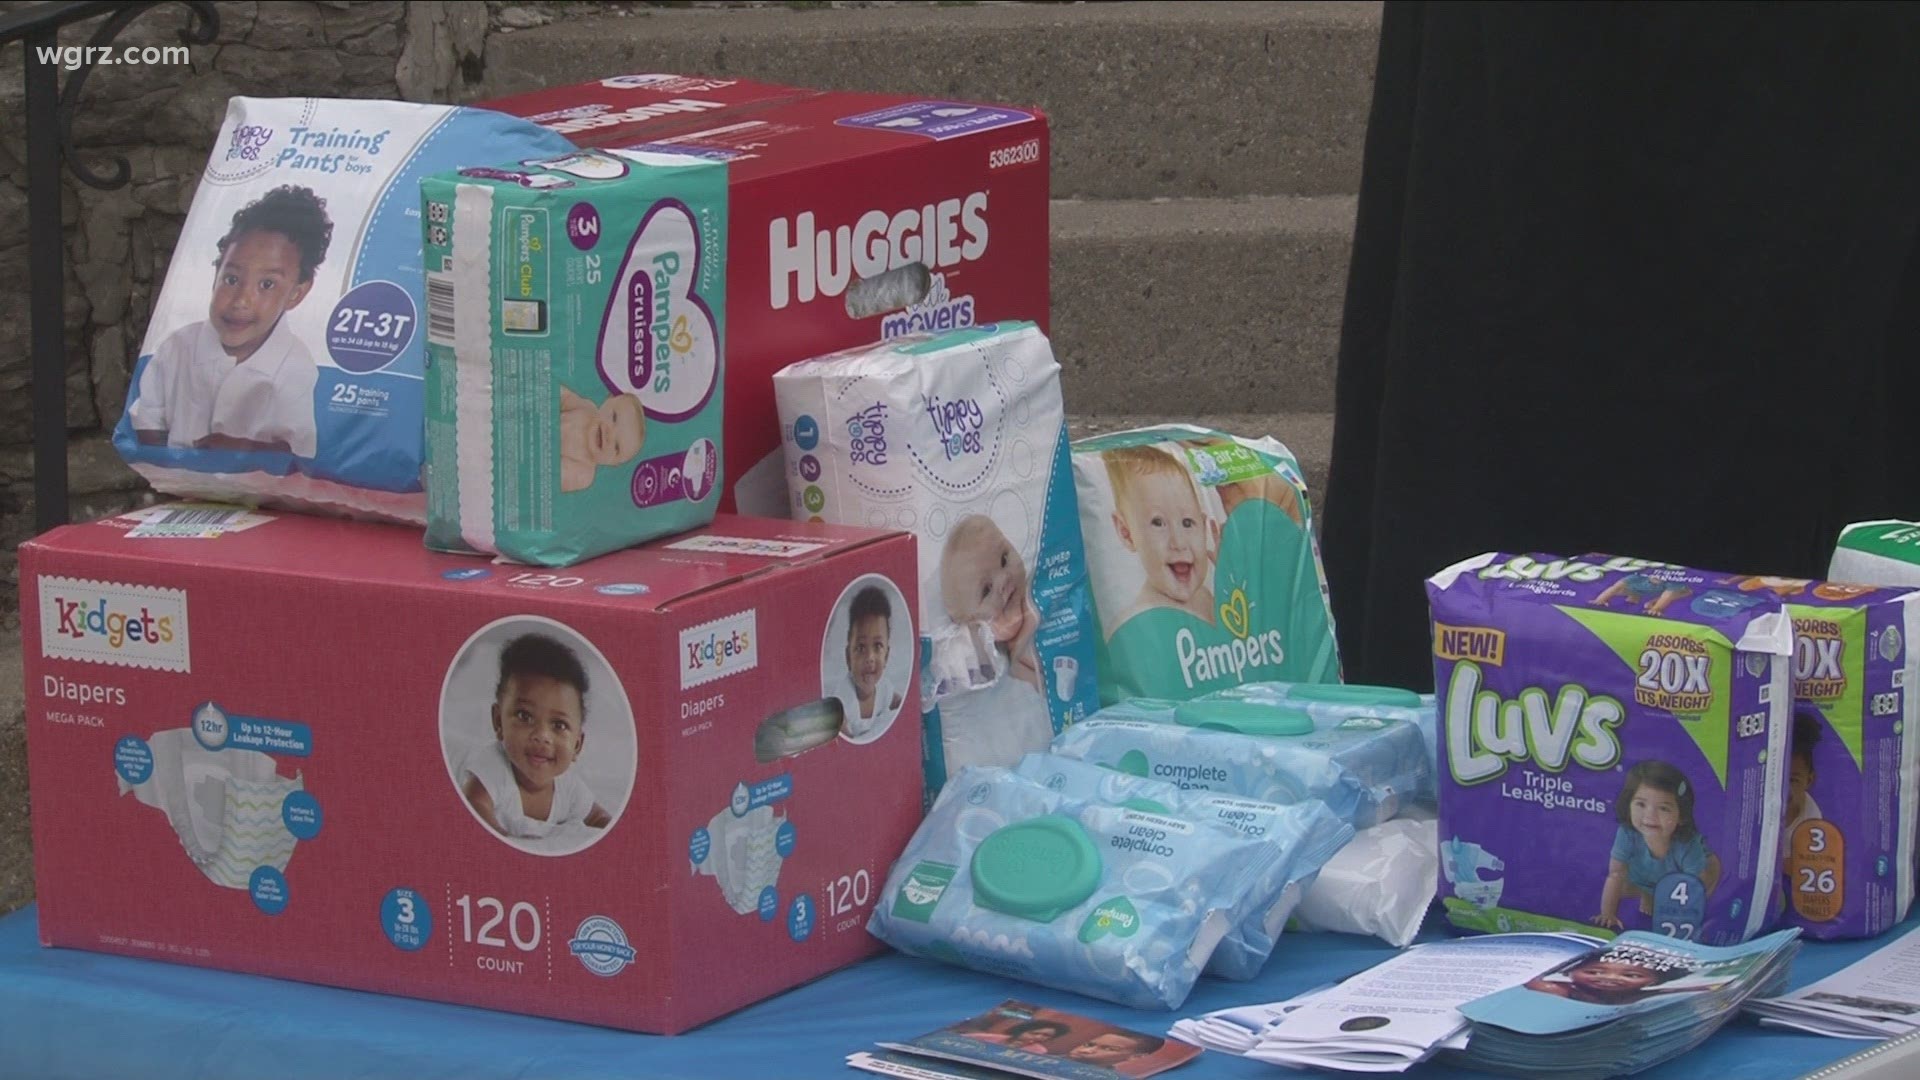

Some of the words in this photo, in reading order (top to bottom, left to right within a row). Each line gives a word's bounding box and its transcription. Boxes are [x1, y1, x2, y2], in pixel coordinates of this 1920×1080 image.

[289, 127, 390, 155] Training
[275, 148, 344, 173] Pants
[345, 161, 372, 175] boys
[577, 216, 597, 236] 3
[520, 214, 535, 262] Pampers
[769, 192, 989, 310] HUGGIES
[521, 264, 532, 297] Club
[586, 254, 601, 285] 25
[334, 308, 410, 339] 2T-3T
[633, 283, 645, 377] cruisers
[651, 251, 680, 394] Pampers
[884, 300, 972, 339] movers
[331, 383, 358, 403] 25
[357, 397, 380, 407] pants
[358, 387, 390, 401] training
[926, 396, 984, 436] tippy
[798, 427, 814, 438] 1
[846, 411, 864, 466] toes
[864, 401, 887, 465] tippy
[940, 431, 982, 462] toes
[804, 461, 817, 474] 2
[808, 493, 820, 504] 3
[508, 573, 584, 588] 120
[1048, 565, 1071, 580] PACK
[1478, 555, 1604, 583] Luvs
[55, 598, 174, 648] Kidgets
[1793, 618, 1839, 636] SORBS
[687, 630, 750, 670] Kidgets
[1442, 629, 1498, 660] NEW!
[1646, 634, 1705, 653] ABSORBS
[1175, 627, 1285, 689] Pampers
[1794, 636, 1843, 681] 0X
[1637, 649, 1711, 695] 20X
[44, 675, 126, 706] Diapers
[1636, 690, 1656, 707] ITS
[1658, 693, 1711, 711] WEIGHT
[681, 693, 725, 719] Diapers
[46, 711, 75, 725] MEGA
[77, 713, 105, 728] PACK
[200, 720, 223, 733] 12hr
[240, 721, 252, 734] Up
[253, 723, 261, 734] to
[263, 724, 293, 738] 12-Hour
[1447, 661, 1623, 784] Luvs
[233, 732, 264, 746] Leakage
[266, 737, 305, 750] Protection
[1154, 761, 1228, 782] complete
[1523, 770, 1573, 793] Triple
[1502, 782, 1606, 814] Leakguards
[1146, 815, 1169, 827] FRESH
[1170, 819, 1186, 831] BABY
[1217, 809, 1257, 824] clean
[1129, 825, 1167, 842] clean
[1809, 829, 1825, 852] 3
[1110, 835, 1174, 859] complete
[1800, 869, 1836, 893] 26
[397, 890, 413, 898] SIZE
[826, 869, 870, 917] 120
[1670, 882, 1689, 905] 4
[397, 898, 416, 924] 3
[456, 894, 541, 951] 120
[796, 902, 806, 921] 3
[1095, 907, 1134, 928] Pampers
[836, 914, 861, 932] COUNT
[1661, 922, 1695, 942] 22
[476, 956, 524, 974] COUNT
